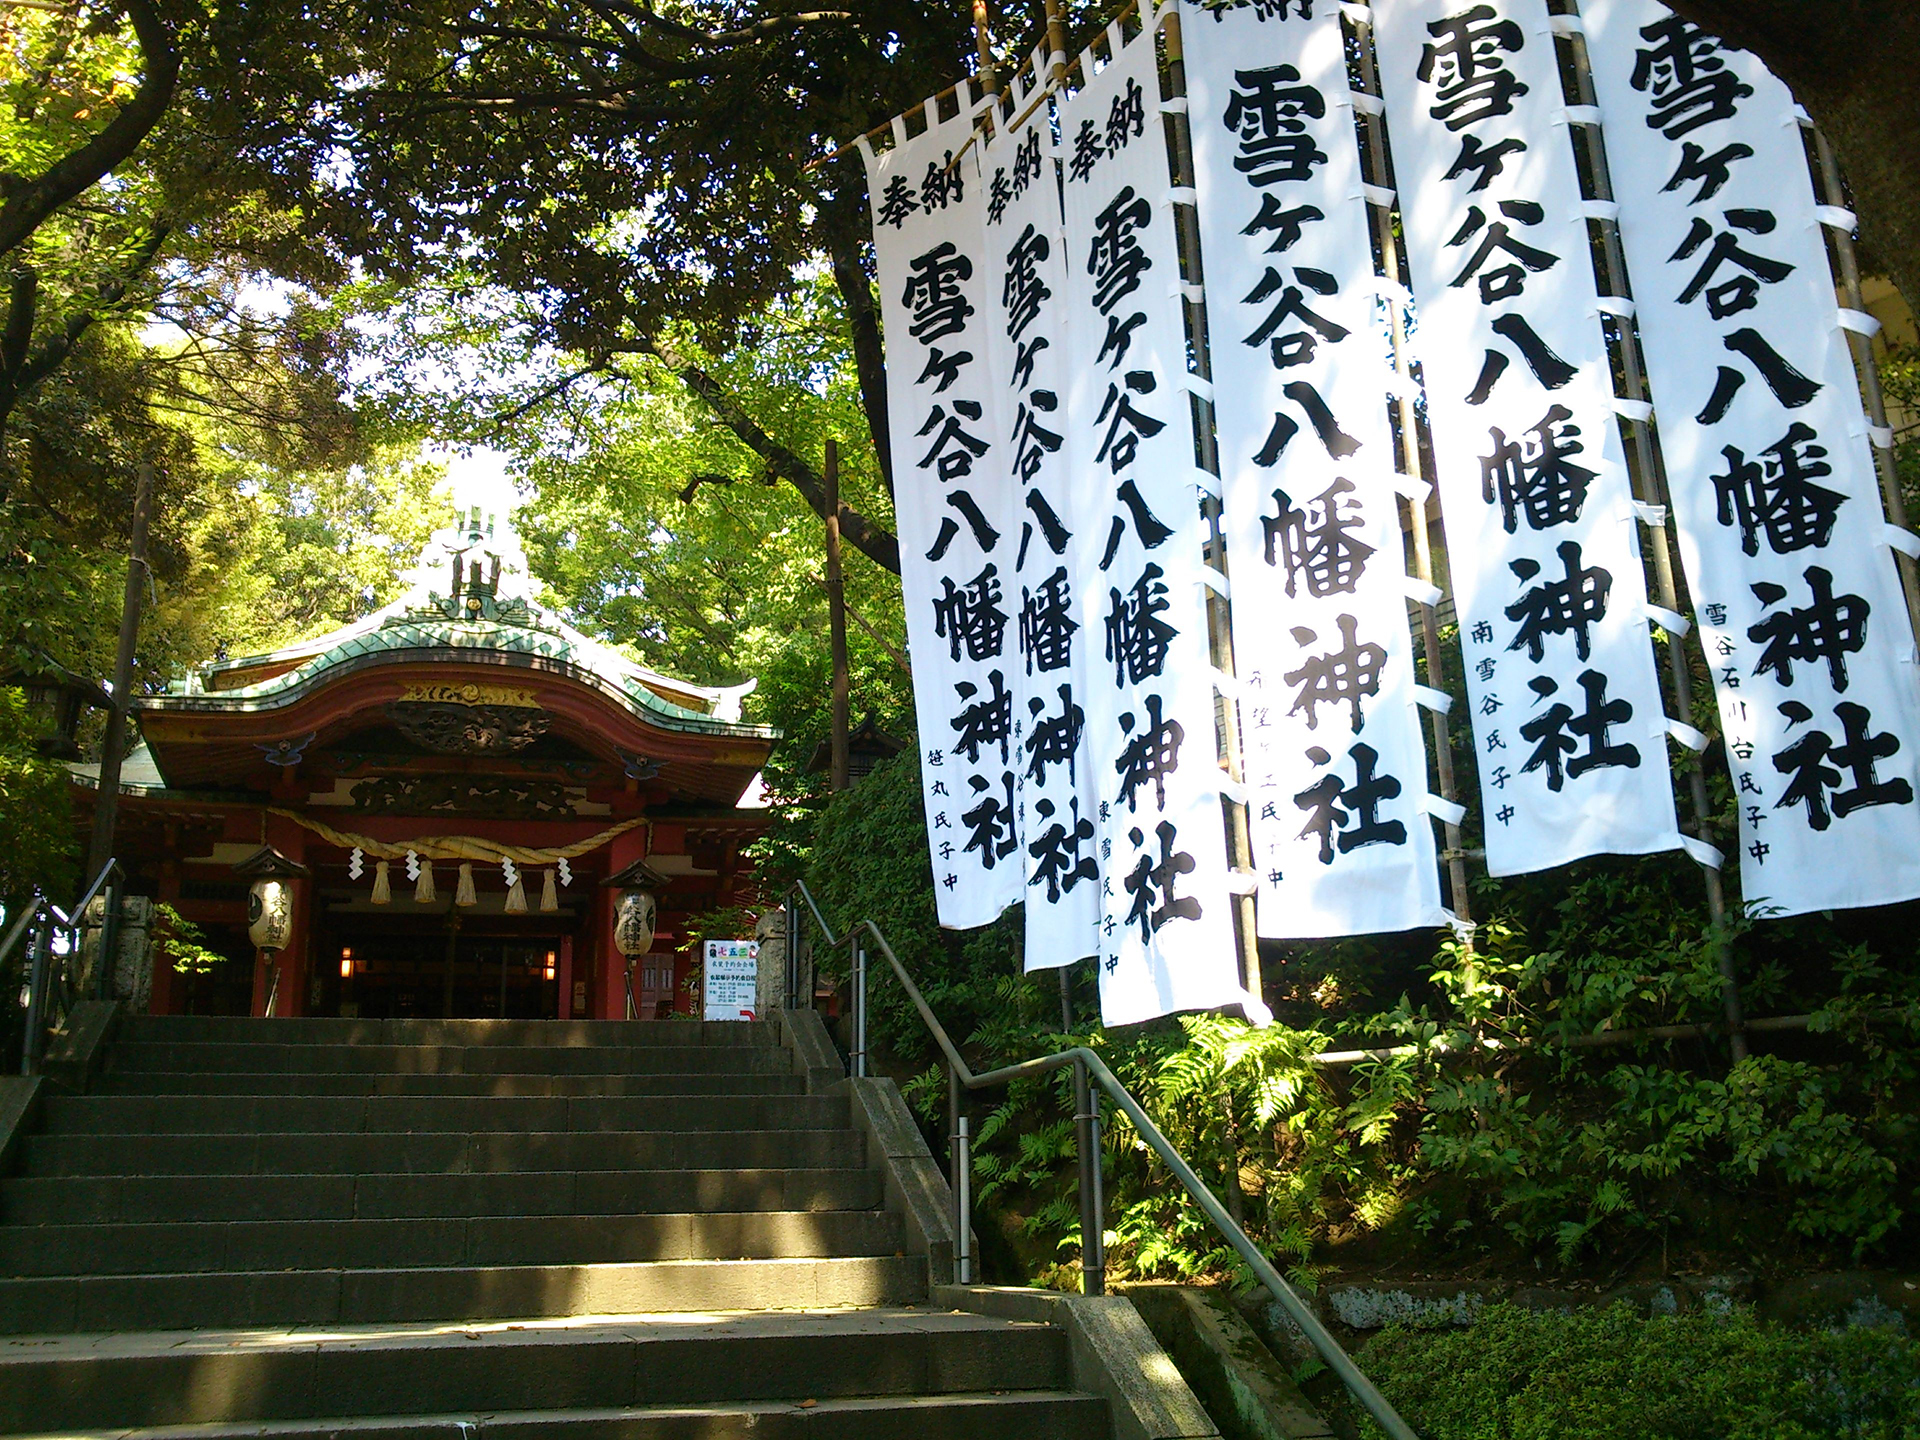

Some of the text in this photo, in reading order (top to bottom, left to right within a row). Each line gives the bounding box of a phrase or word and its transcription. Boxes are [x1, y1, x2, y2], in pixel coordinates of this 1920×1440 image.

[877, 149, 964, 230] 奉納
[987, 125, 1042, 226] 奉納
[1068, 77, 1146, 183] 奉納
[1223, 64, 1408, 864] 雪ヶ谷八幡神社
[1417, 5, 1642, 792] 雪ヶ谷八幡神社
[1002, 223, 1099, 904] 雪ヶ谷八幡神社
[1087, 186, 1201, 946] 雪ヶ谷八幡神社
[1472, 621, 1515, 826] 南雪谷氏子中
[1706, 603, 1770, 865] 雪谷石川台氏子中
[928, 749, 957, 892] 笹丸氏子中
[1099, 801, 1118, 975] 東雪氏子中
[718, 946, 748, 957] 七五三
